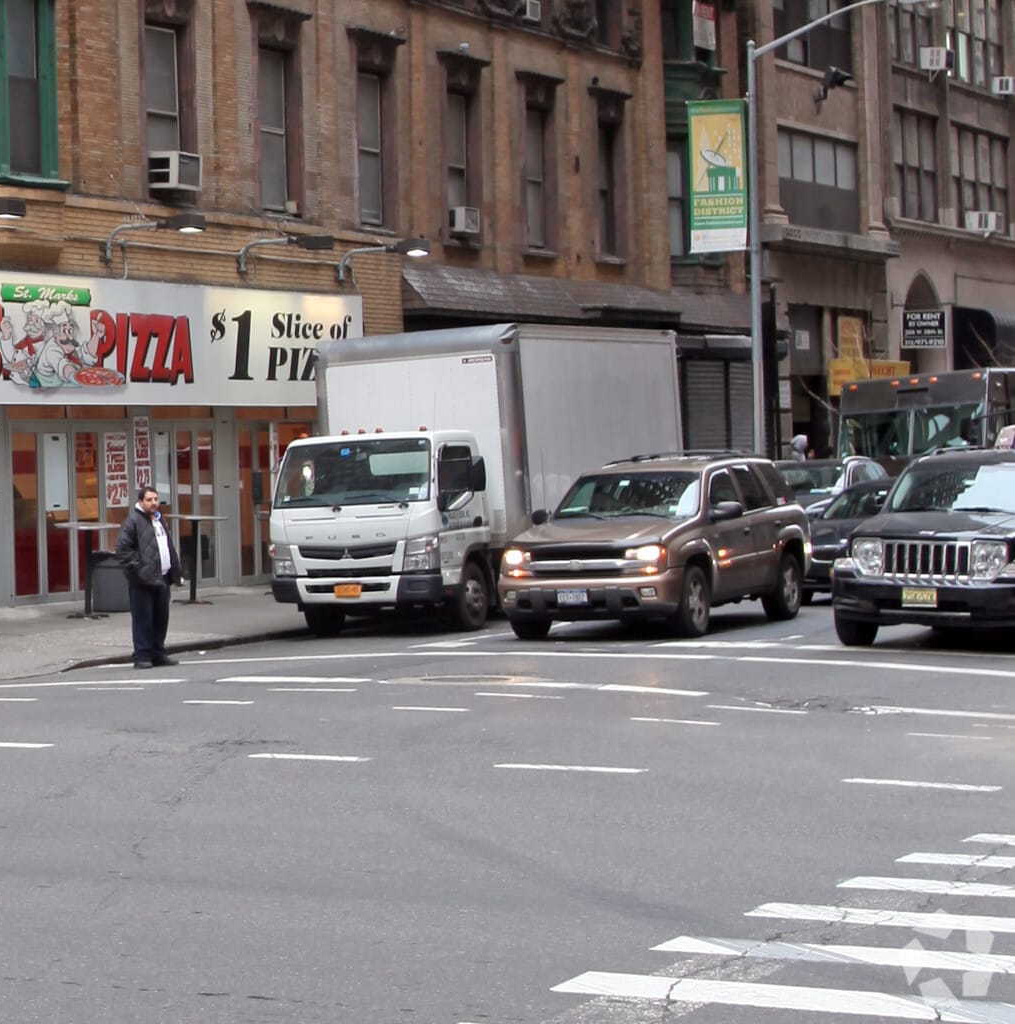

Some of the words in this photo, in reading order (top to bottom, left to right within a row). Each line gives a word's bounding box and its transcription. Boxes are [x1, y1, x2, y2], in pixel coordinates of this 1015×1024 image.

[694, 197, 743, 206] FASHION
[694, 206, 743, 216] DISTRICT
[12, 285, 33, 299] St.
[38, 288, 80, 302] Marks
[922, 312, 941, 320] RENT
[90, 308, 195, 386] PIZZA
[210, 308, 255, 381] $1
[270, 311, 324, 340] Slice
[330, 314, 352, 340] of
[266, 346, 318, 381] PIZ
